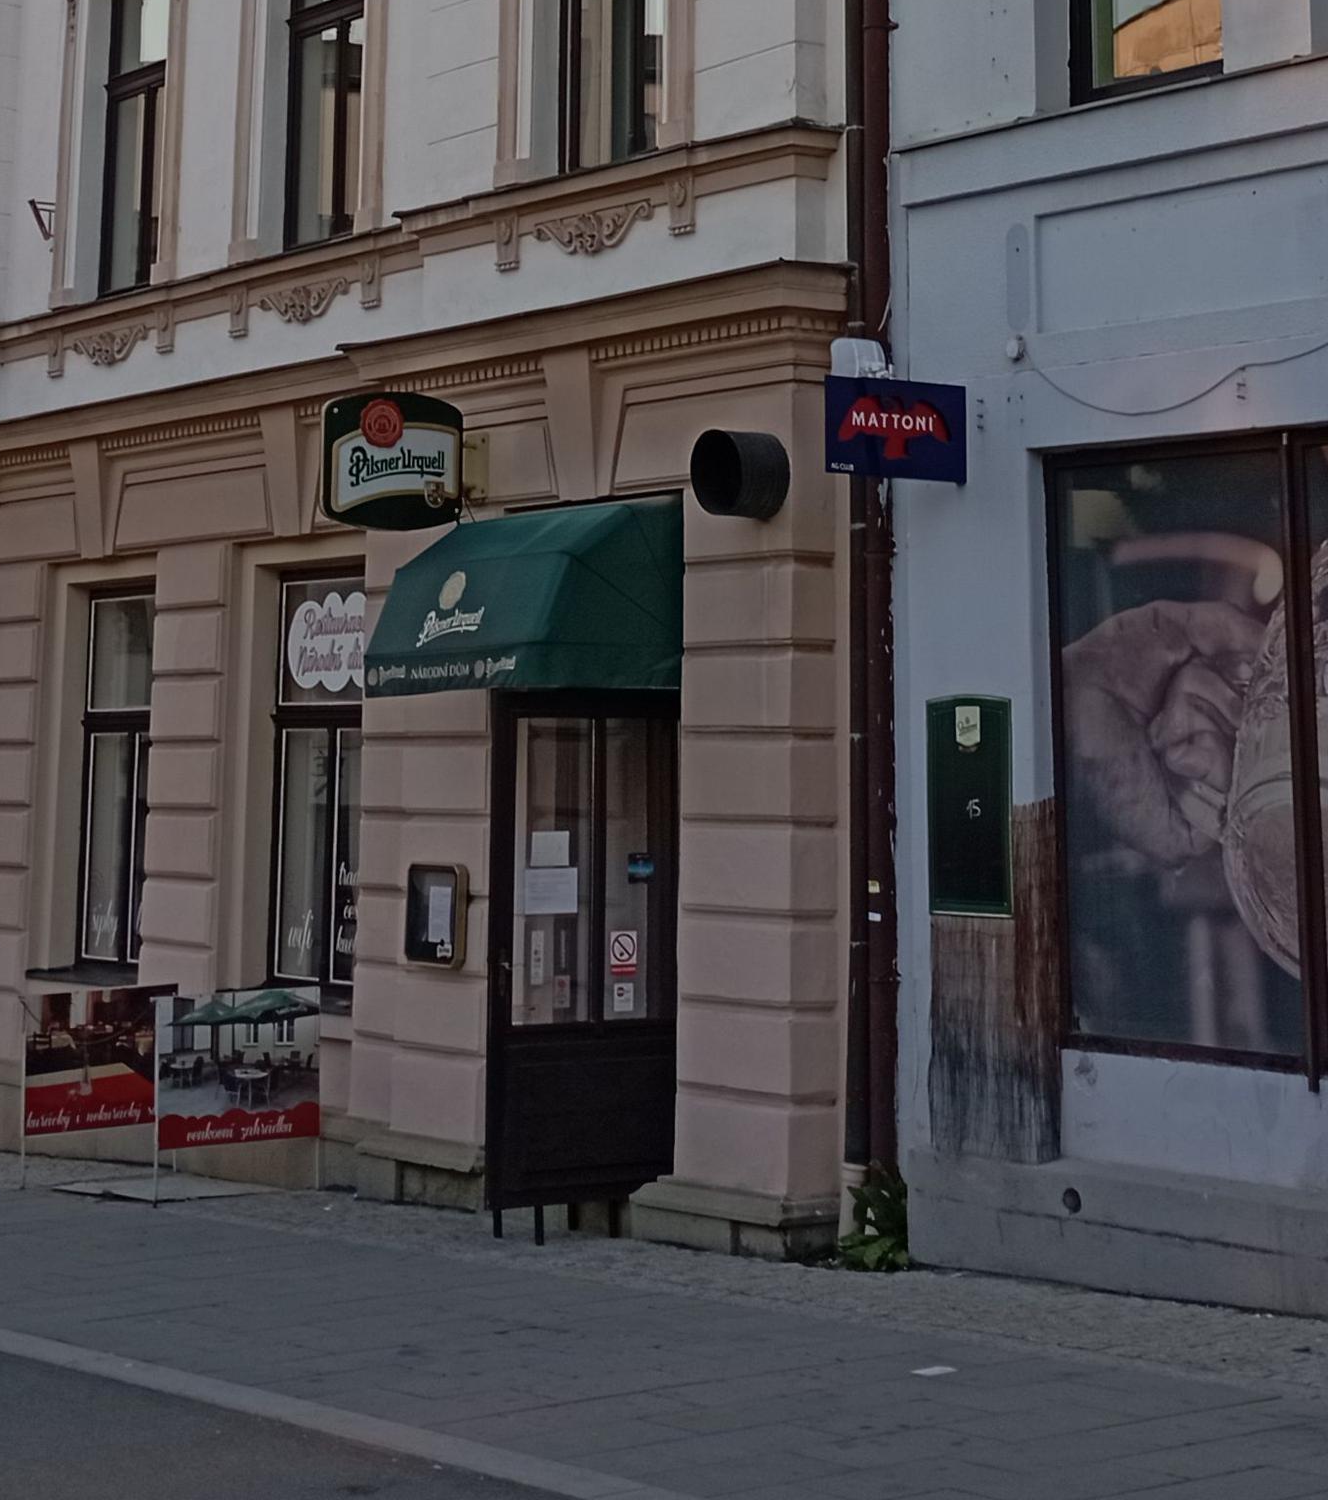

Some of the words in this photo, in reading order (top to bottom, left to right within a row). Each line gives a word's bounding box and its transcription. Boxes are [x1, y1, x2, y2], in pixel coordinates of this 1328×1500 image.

[852, 410, 934, 432] MATTONI
[349, 446, 400, 487] Pilsner
[400, 446, 445, 478] Urquell
[410, 662, 449, 679] NÁRODNÍ
[449, 661, 470, 677] DŮM
